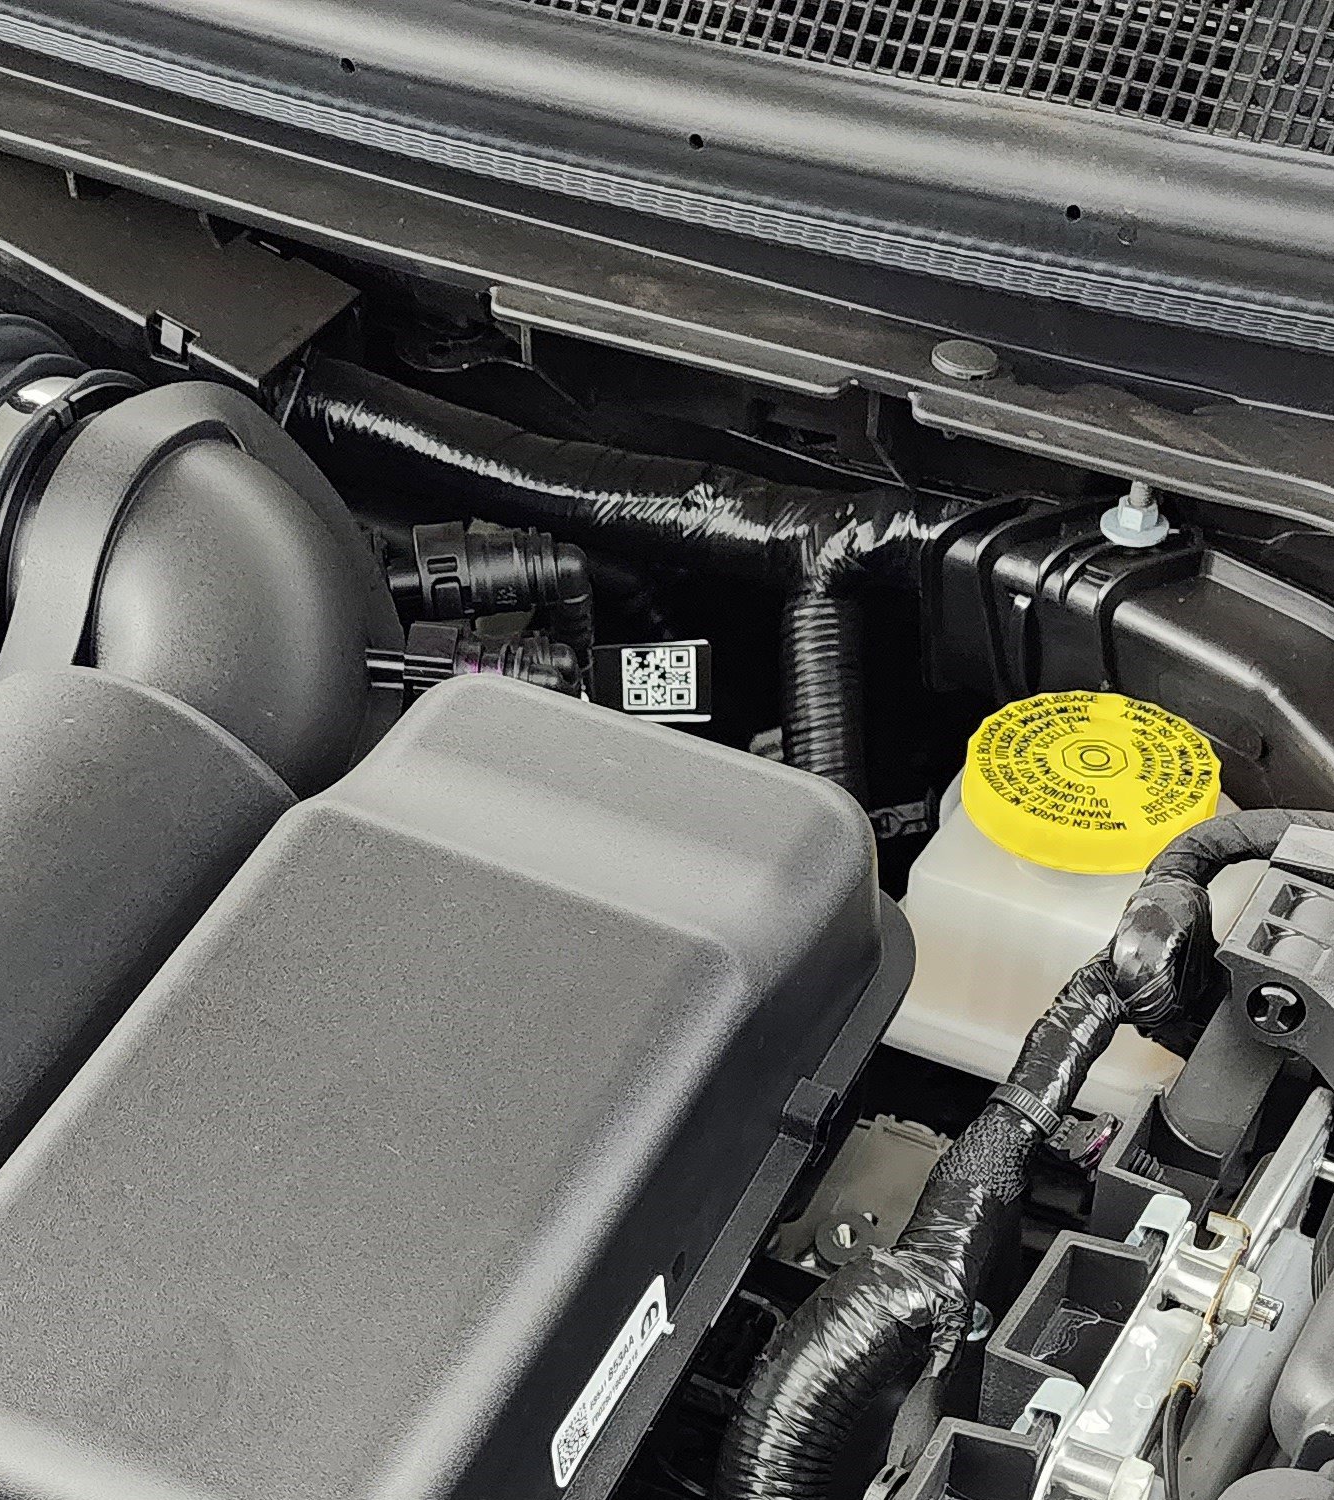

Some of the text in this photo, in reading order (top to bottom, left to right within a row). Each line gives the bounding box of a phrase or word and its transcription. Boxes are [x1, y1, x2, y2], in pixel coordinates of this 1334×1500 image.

[1015, 695, 1097, 714] REMPLISSAGE
[1002, 709, 1018, 722] DE
[1014, 704, 1089, 730] UNIQUEMENT
[1120, 711, 1154, 727] ONLY
[977, 720, 1003, 754] BOUCHON
[1014, 719, 1057, 758] PROVENANT
[1155, 725, 1178, 741] USE
[995, 729, 1017, 759] UTILISER
[1183, 732, 1210, 760] SEALED
[977, 756, 991, 765] LE
[1132, 728, 1175, 797] CLEAN FILLER CAP
[1017, 768, 1039, 786] DOT
[1032, 752, 1095, 794] CONTENANT
[980, 767, 1025, 807] NETTOYER
[1036, 784, 1086, 807] LIQUIDE
[1028, 793, 1045, 805] LE
[1049, 802, 1066, 813] DE
[1089, 797, 1108, 809] DU
[1141, 789, 1184, 814] BEFORE
[1175, 790, 1204, 813] FLUID
[1068, 807, 1111, 819] AVANT
[1145, 810, 1174, 826] DOT
[1073, 818, 1090, 830] EN
[1095, 821, 1127, 831] MISE
